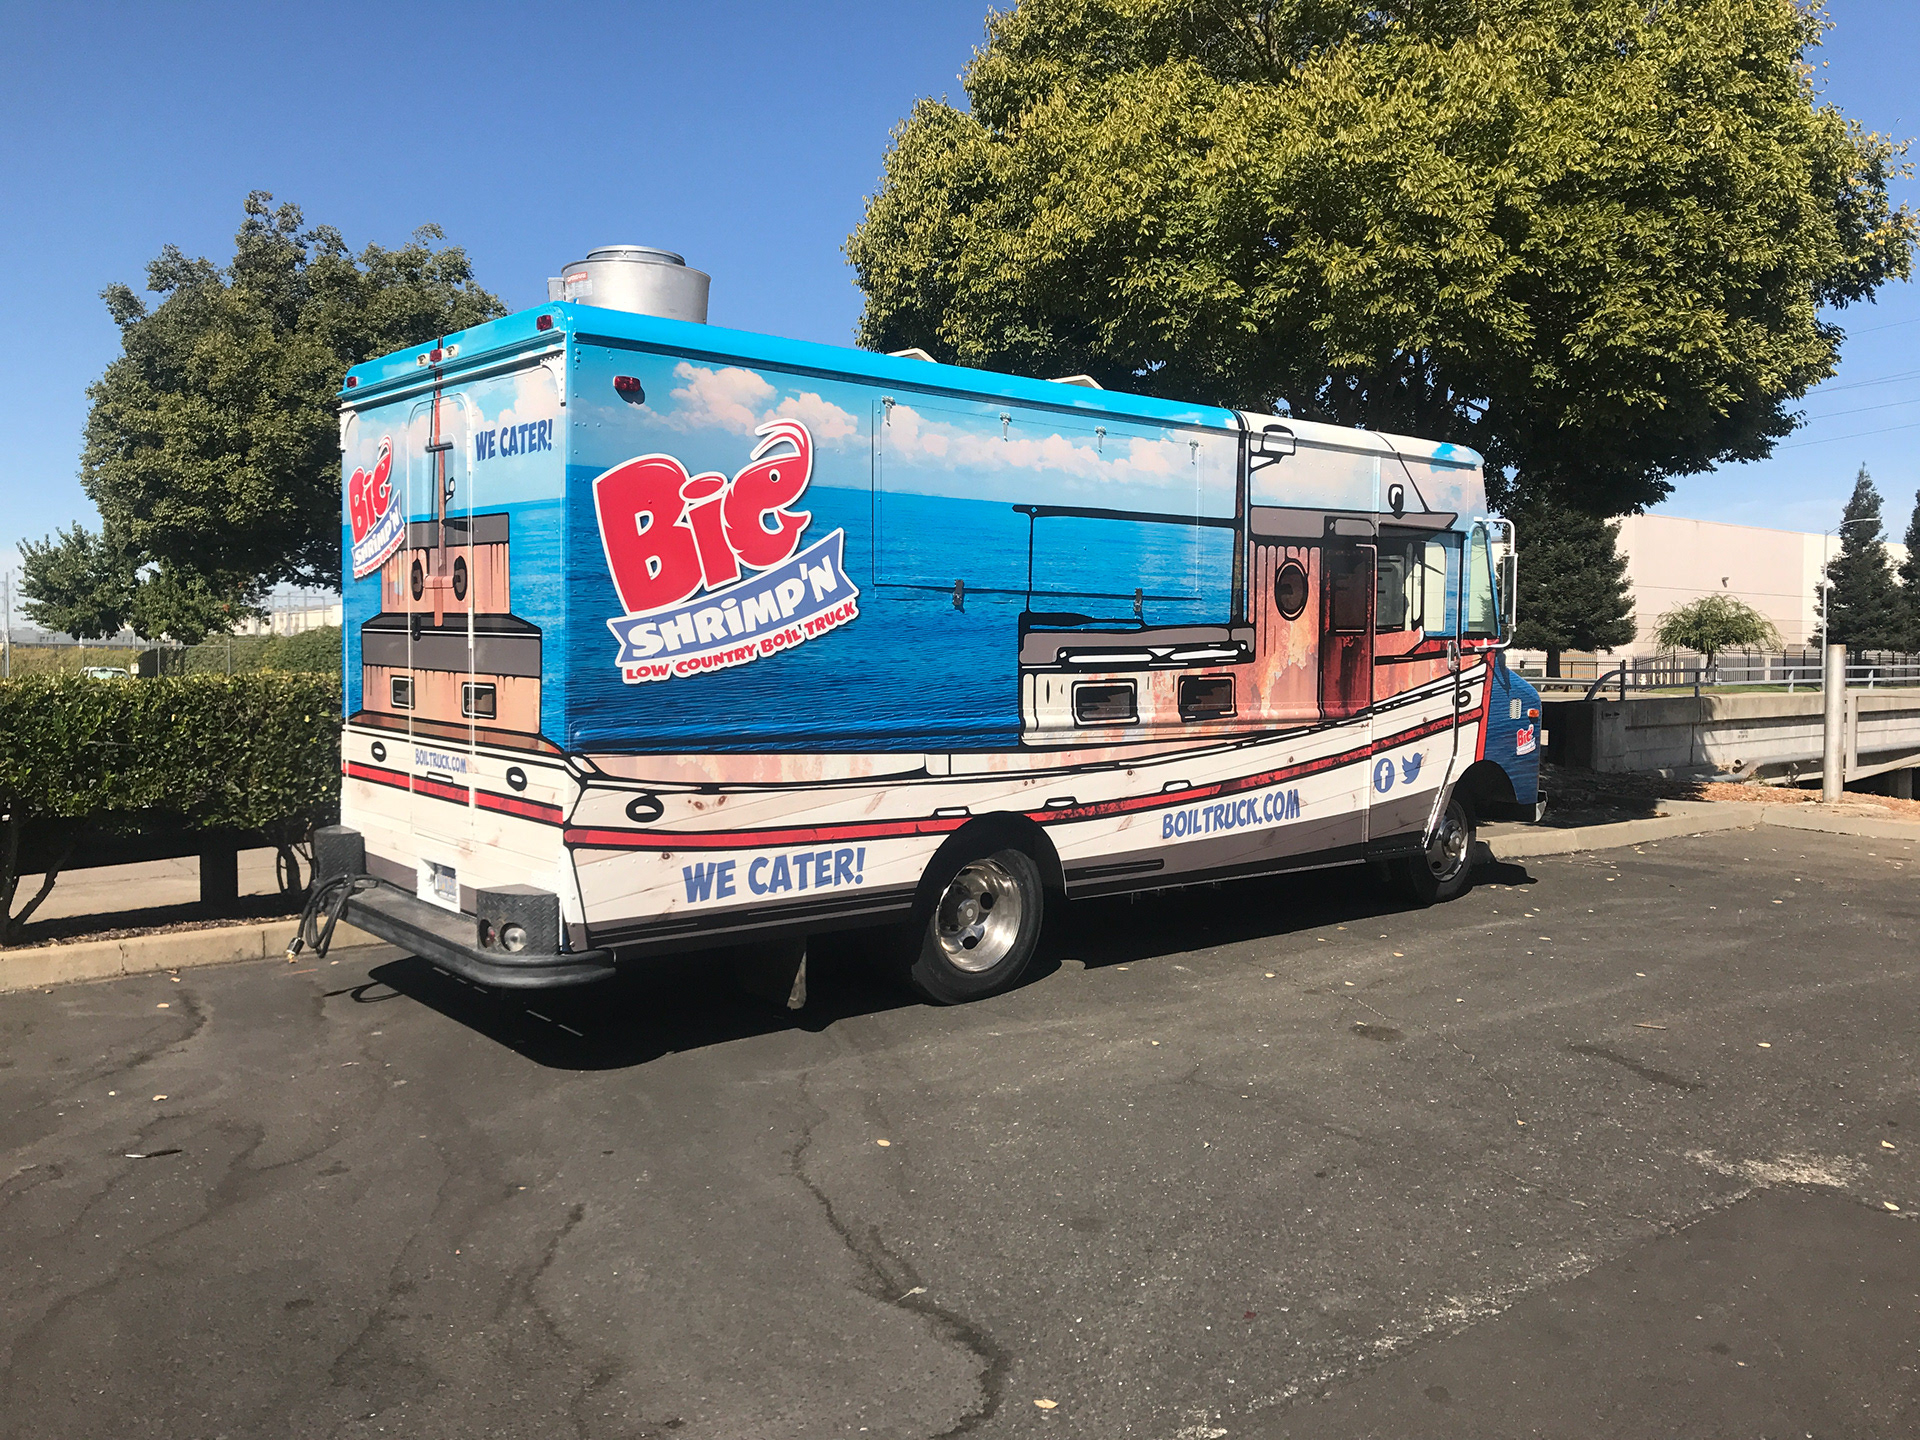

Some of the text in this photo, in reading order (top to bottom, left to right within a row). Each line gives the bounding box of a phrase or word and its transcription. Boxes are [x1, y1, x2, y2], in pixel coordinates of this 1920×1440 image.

[475, 418, 553, 462] WE CATER!
[626, 663, 670, 680] LOW
[675, 643, 758, 674] COUNTRY
[804, 601, 857, 636] TRUCK
[415, 748, 467, 774] BOILTRUCK.COM
[1162, 788, 1301, 840] BOILTRUCK.COM
[682, 847, 866, 904] WE CATER!
